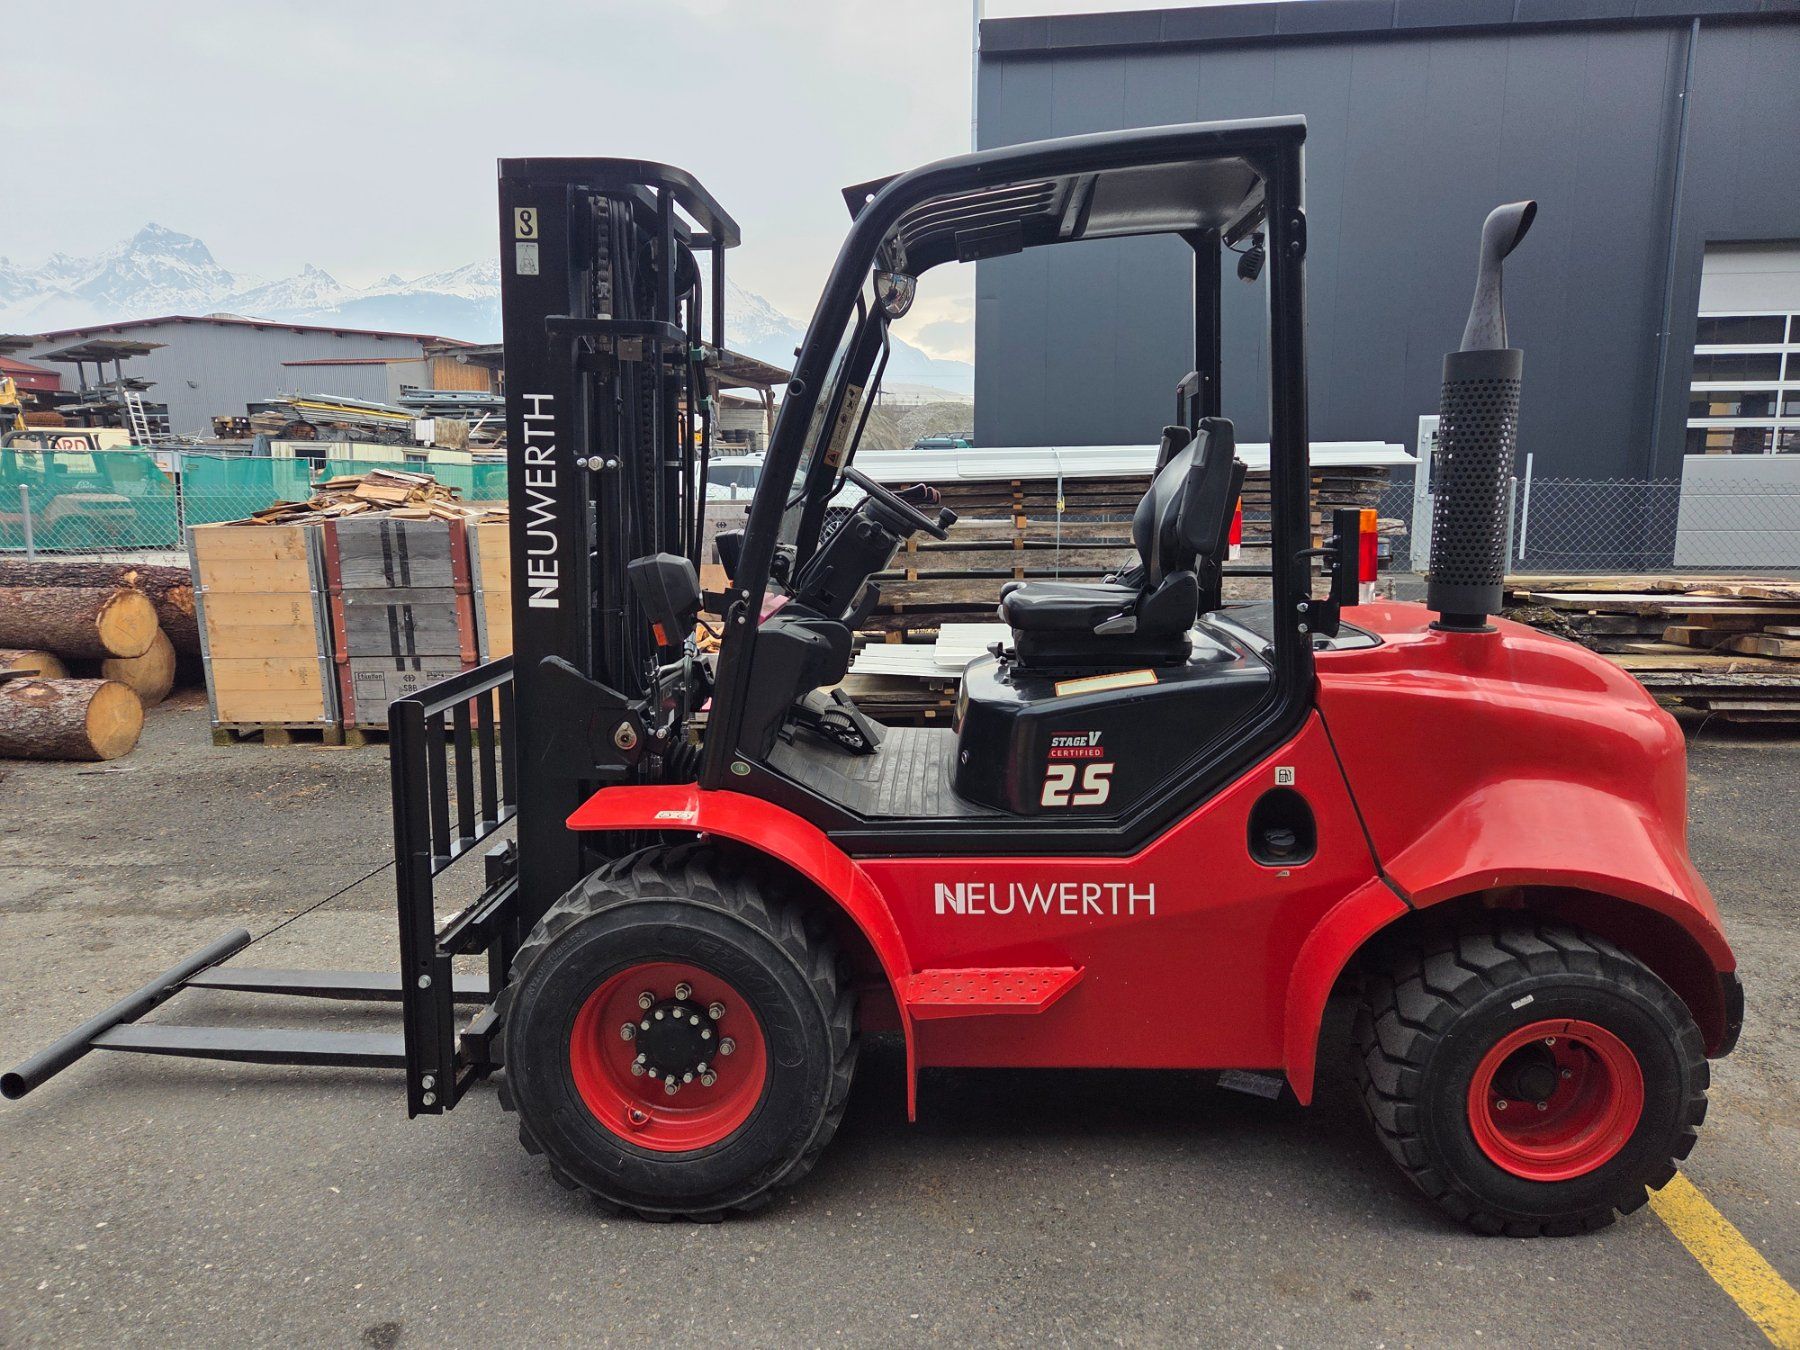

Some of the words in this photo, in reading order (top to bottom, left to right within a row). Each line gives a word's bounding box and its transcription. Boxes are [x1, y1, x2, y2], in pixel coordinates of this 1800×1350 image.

[523, 393, 560, 609] NEUWERTH
[403, 684, 418, 692] SBB
[1051, 736, 1087, 747] STAGE
[1088, 731, 1102, 747] V
[1051, 748, 1100, 757] CERTIFIED
[934, 882, 1156, 915] NEUWERTH
